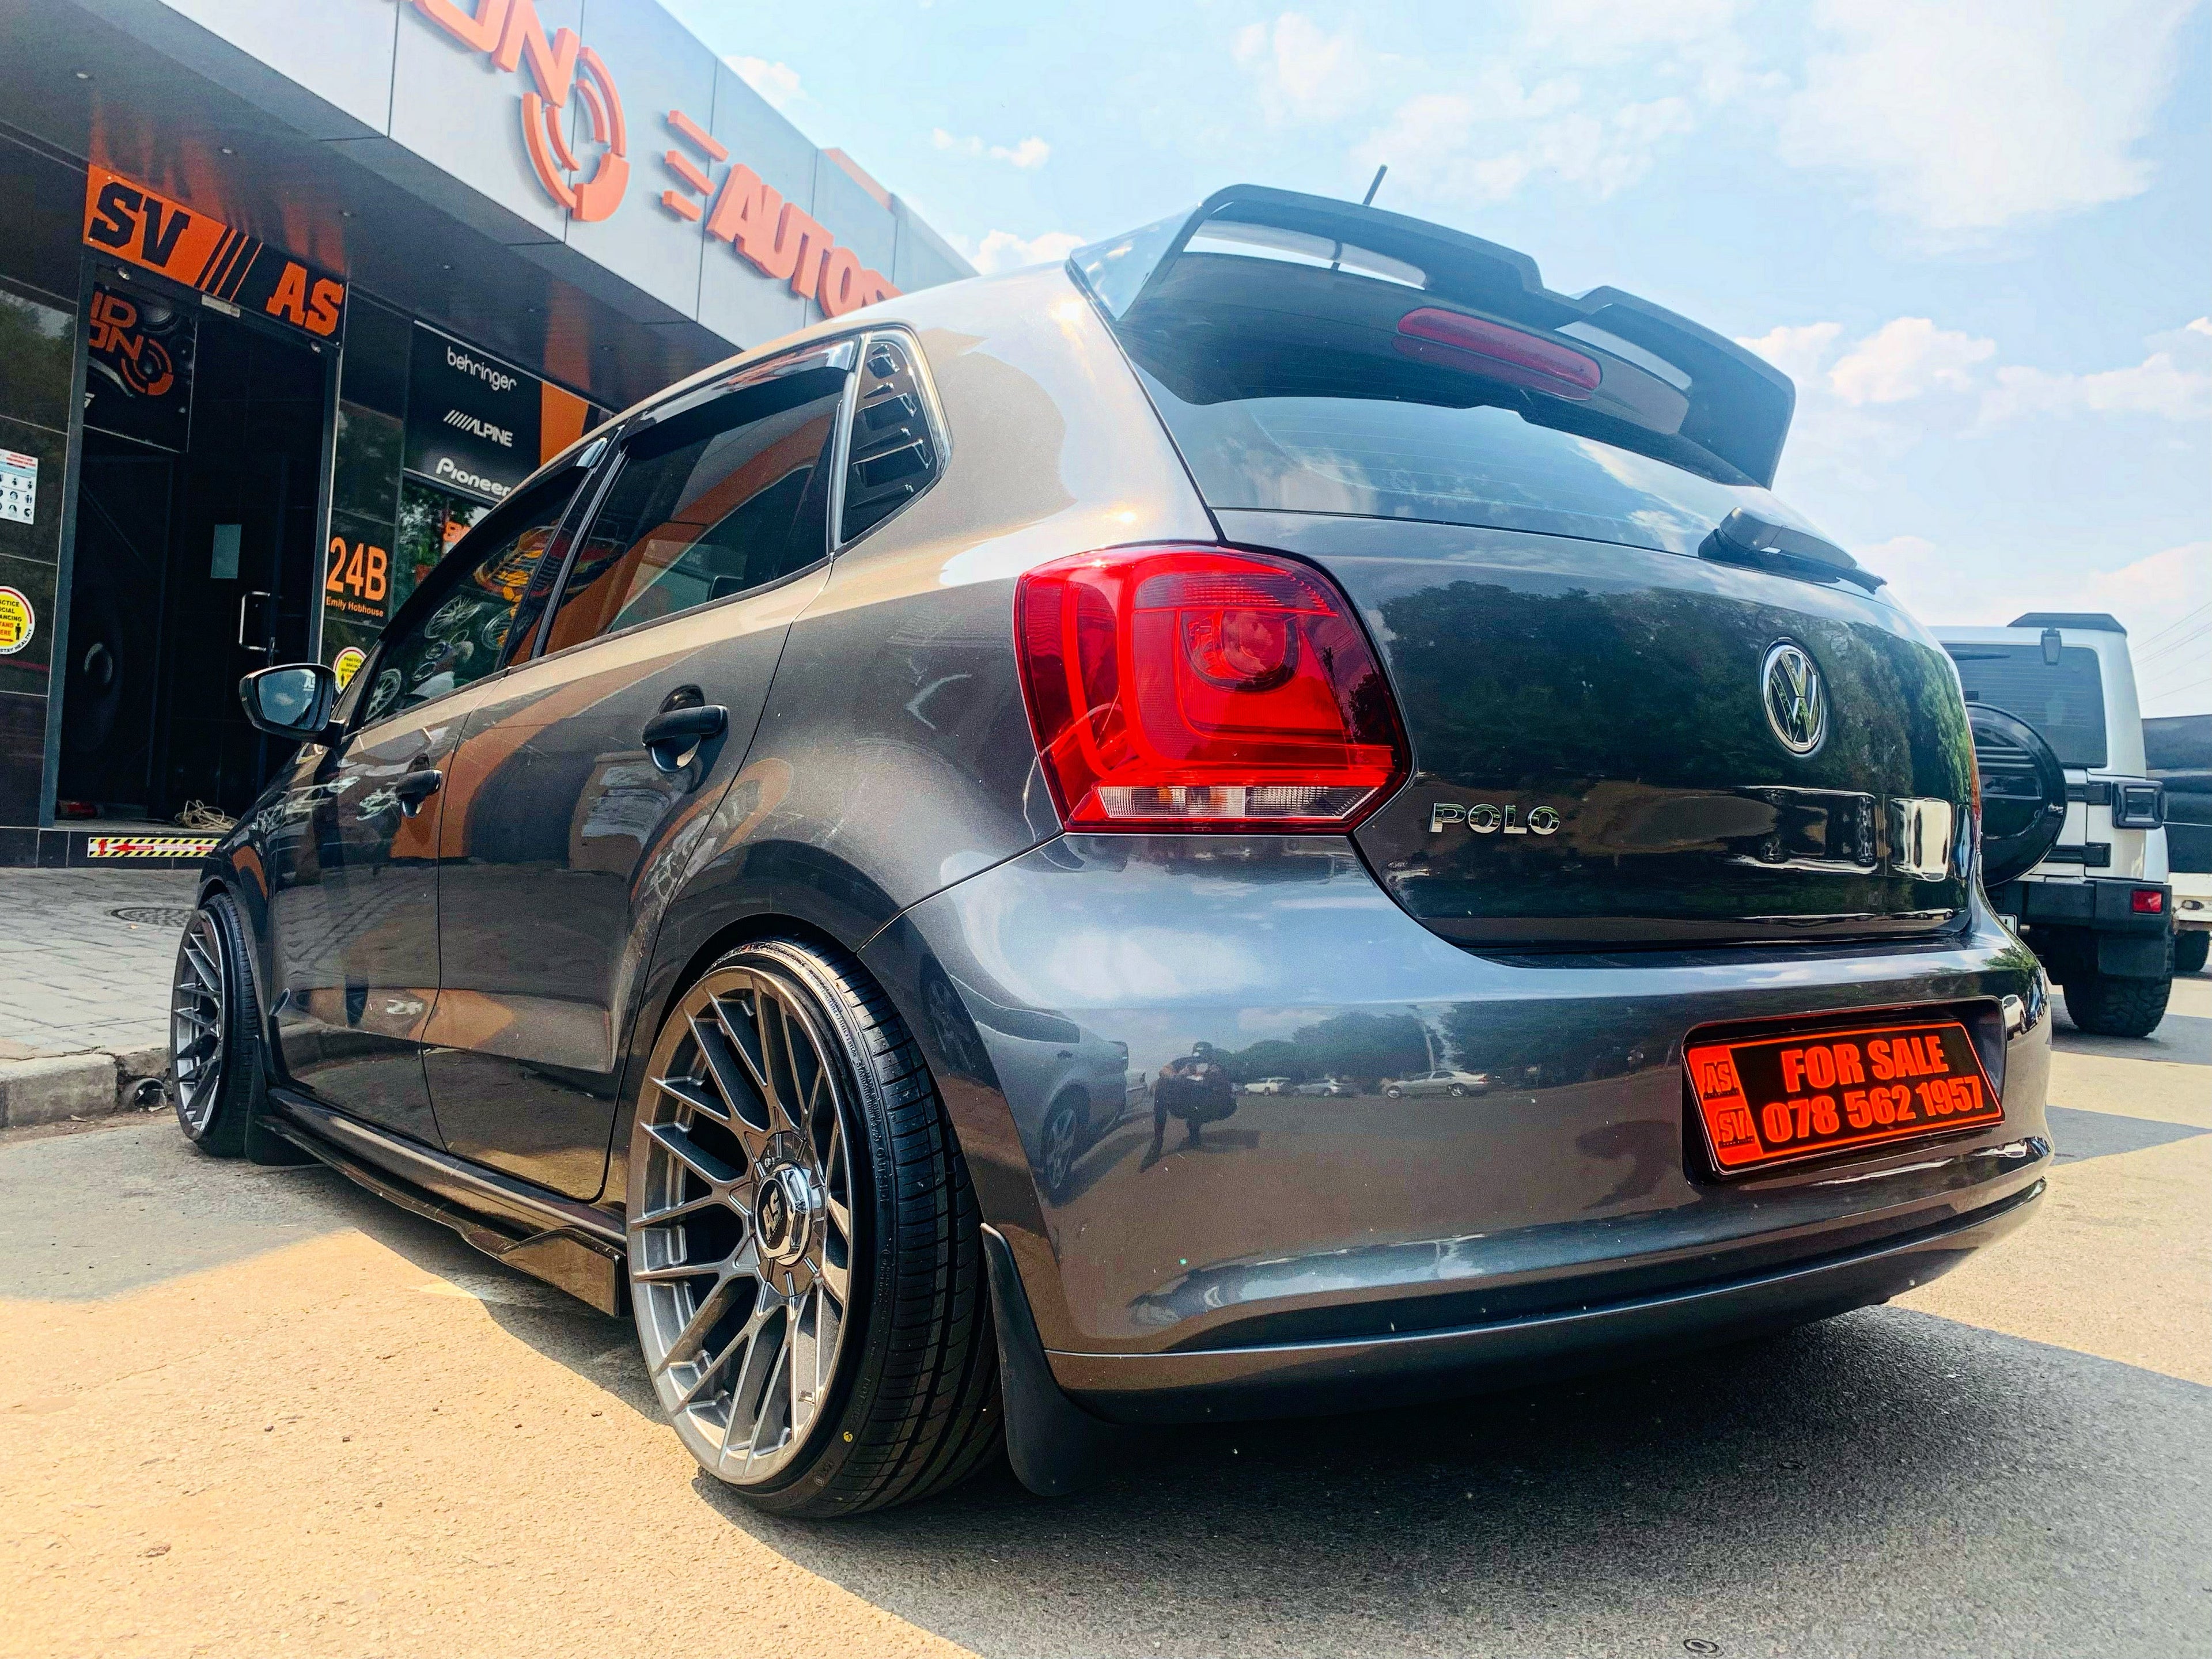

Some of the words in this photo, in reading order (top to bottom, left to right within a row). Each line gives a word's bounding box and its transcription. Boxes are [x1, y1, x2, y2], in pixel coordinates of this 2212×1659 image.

[88, 181, 191, 267] SV
[265, 261, 345, 336] AS
[446, 346, 517, 391] behringer
[435, 457, 512, 497] Pioneer
[327, 536, 387, 601] 24B
[326, 596, 347, 611] Emily
[348, 601, 384, 617] Hobhouse
[1429, 802, 1560, 835] POLO
[1705, 1063, 1732, 1093] AS
[1781, 1043, 1865, 1093] FOR
[1868, 1036, 1949, 1080] SALE
[1719, 1111, 1746, 1142] SV
[1762, 1096, 1840, 1143] 078
[1843, 1085, 1916, 1128] 562
[1915, 1075, 1984, 1117] 1957
